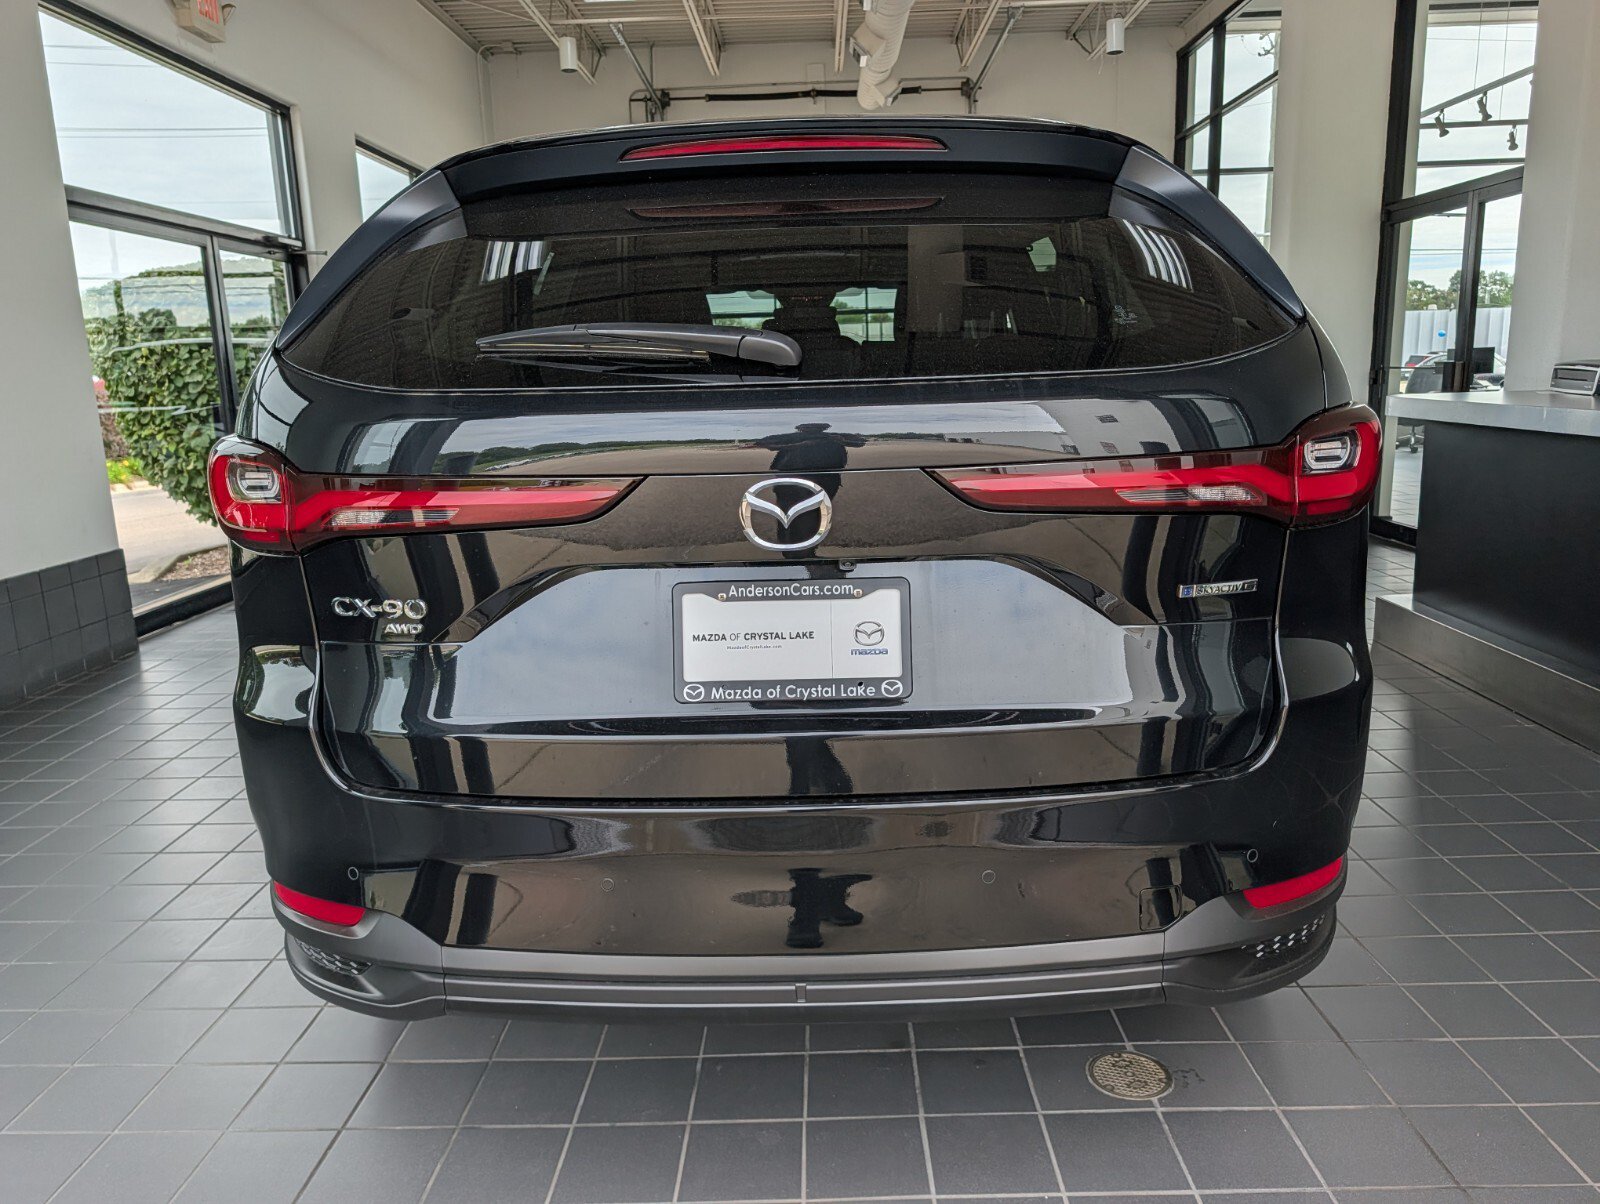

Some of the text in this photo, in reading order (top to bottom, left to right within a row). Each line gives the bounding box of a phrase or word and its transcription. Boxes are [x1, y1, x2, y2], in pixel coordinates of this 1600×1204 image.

[729, 583, 854, 598] AndersonCars.com
[331, 597, 427, 619] CX-90
[384, 623, 423, 634] AWD
[692, 631, 815, 642] MAZDA OF CRYSTAL LAKE
[711, 682, 876, 700] Mazda of Crystal Lake
